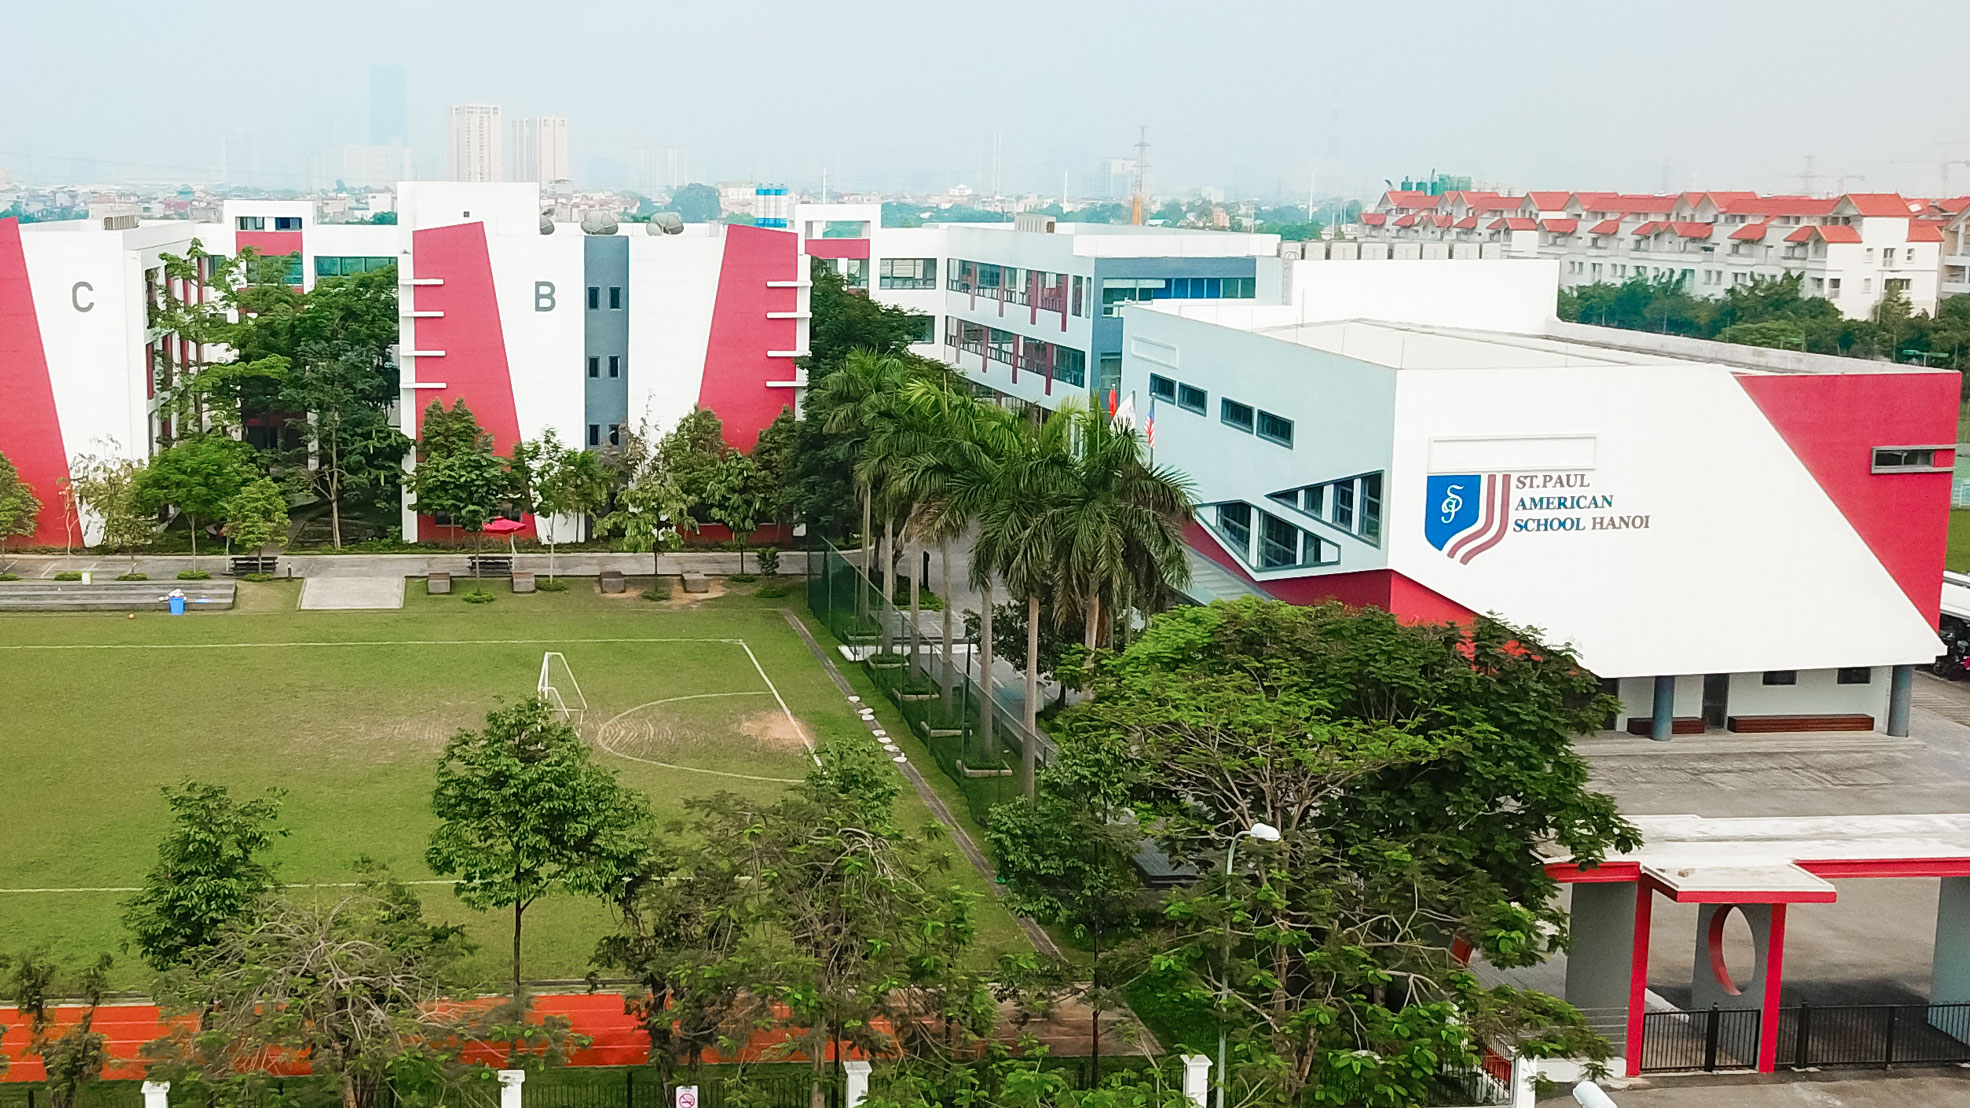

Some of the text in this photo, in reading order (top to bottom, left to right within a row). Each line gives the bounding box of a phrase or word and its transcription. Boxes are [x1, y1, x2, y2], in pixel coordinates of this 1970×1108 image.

[72, 281, 94, 312] C
[535, 281, 556, 312] B
[1514, 494, 1614, 511] AMERICAN
[1513, 514, 1651, 533] SCHOOL HANOI
